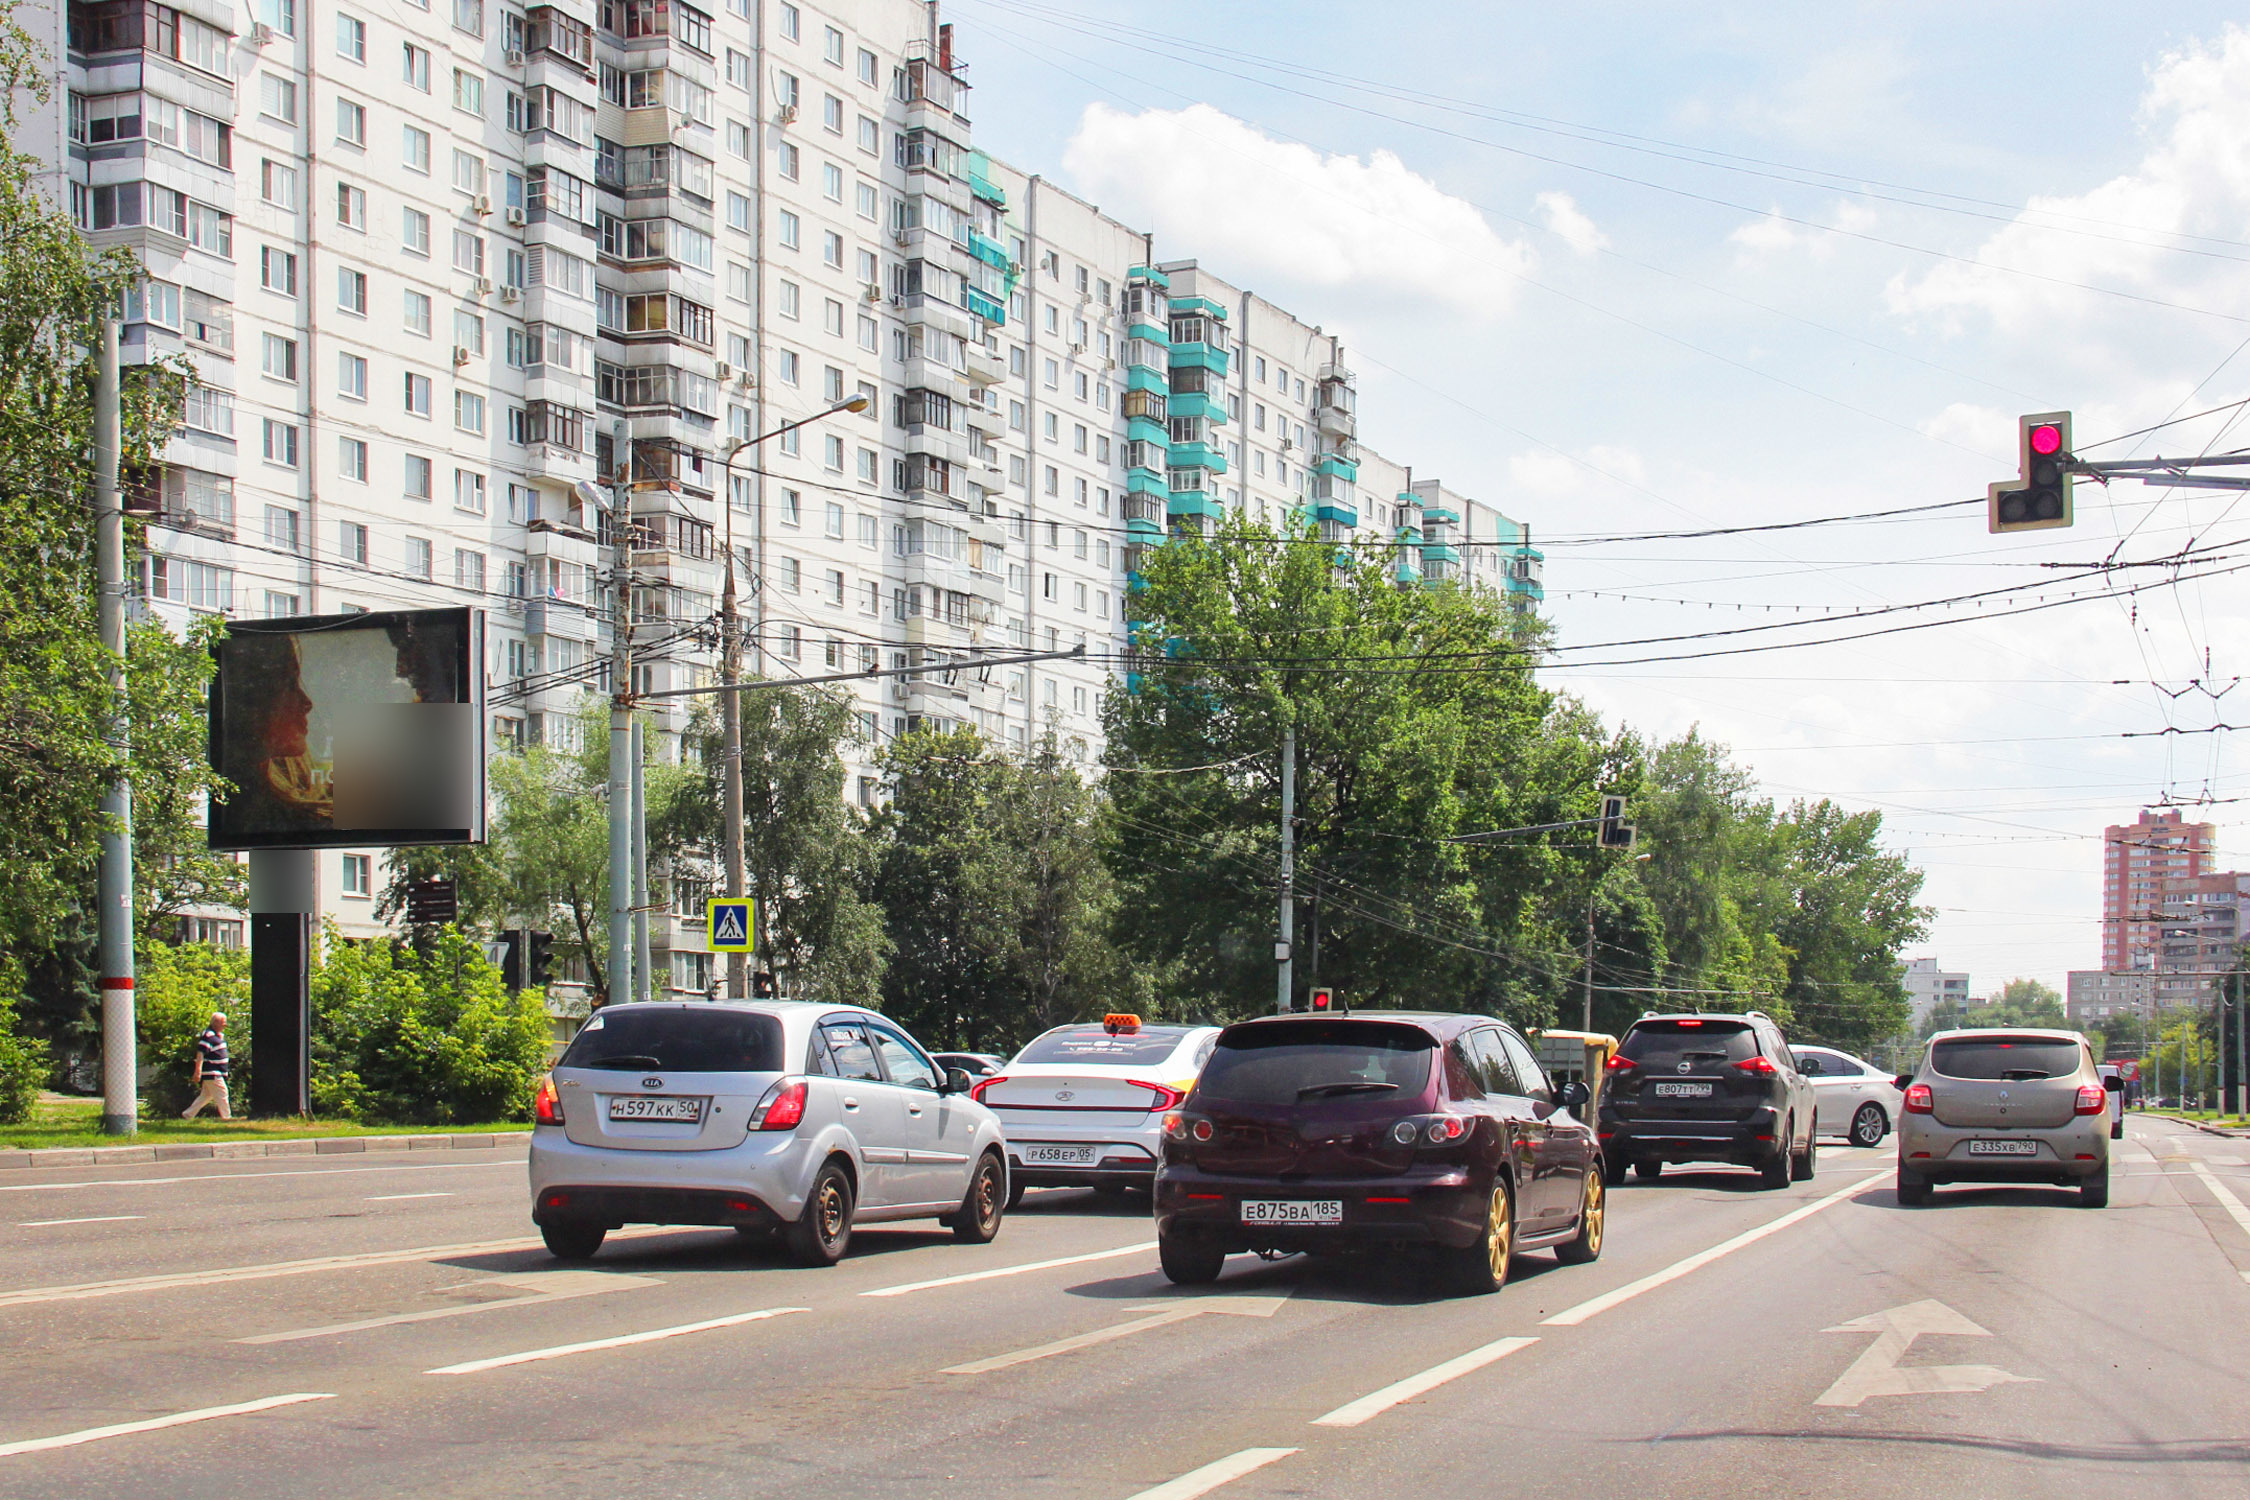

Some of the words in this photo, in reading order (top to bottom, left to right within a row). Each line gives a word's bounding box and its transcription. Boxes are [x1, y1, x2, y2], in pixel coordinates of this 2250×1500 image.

[616, 1101, 675, 1116] Н597КК
[679, 1101, 695, 1113] 50
[1973, 1142, 2015, 1152] Е335ХВ
[1031, 1148, 1076, 1160] Р658ЕР
[1079, 1148, 1091, 1158] 05
[1246, 1203, 1310, 1219] Е875ВА
[1313, 1202, 1338, 1214] 185
